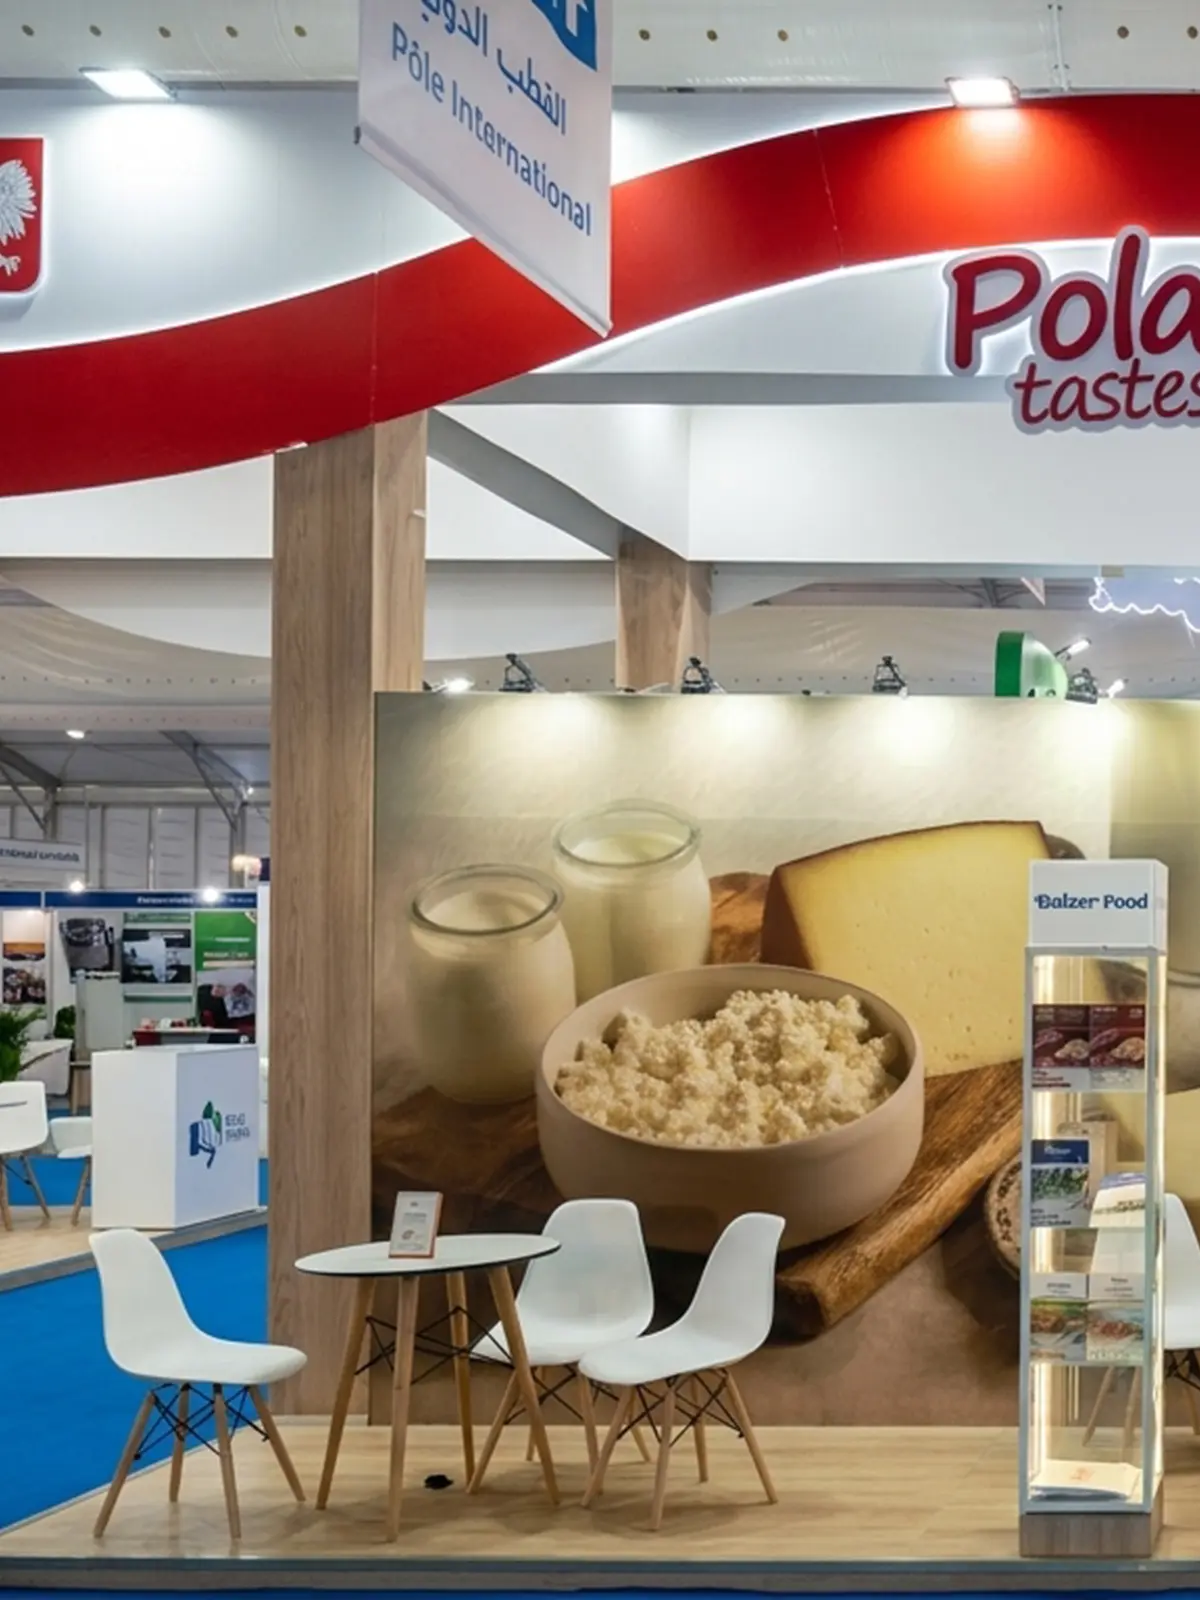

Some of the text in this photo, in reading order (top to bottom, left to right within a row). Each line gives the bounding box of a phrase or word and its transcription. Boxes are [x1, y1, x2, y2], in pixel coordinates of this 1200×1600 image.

[392, 21, 591, 237] Pôle International
[420, 0, 567, 136] القطب الدو
[1033, 892, 1100, 909] Balzer
